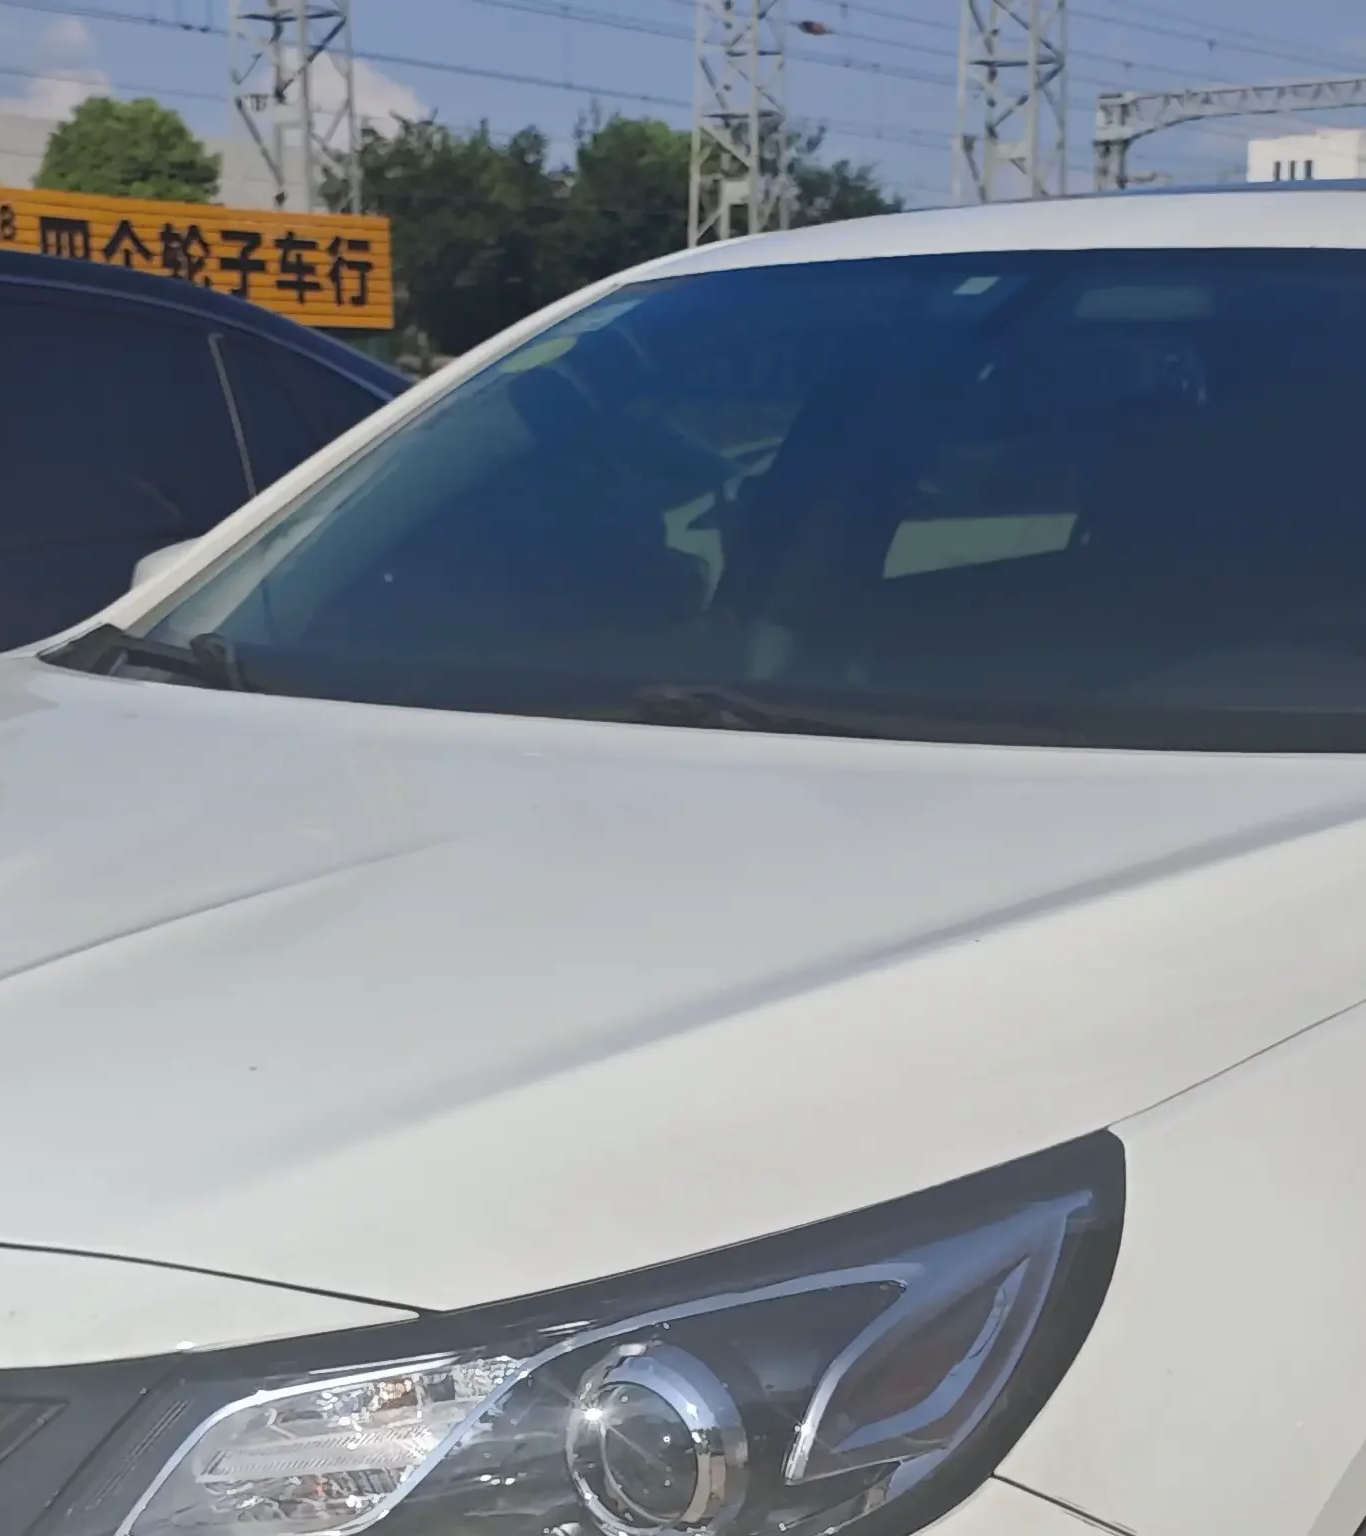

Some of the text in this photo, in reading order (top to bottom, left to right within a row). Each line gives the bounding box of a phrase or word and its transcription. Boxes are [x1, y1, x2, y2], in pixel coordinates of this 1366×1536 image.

[39, 216, 374, 306] 四个轮子车行
